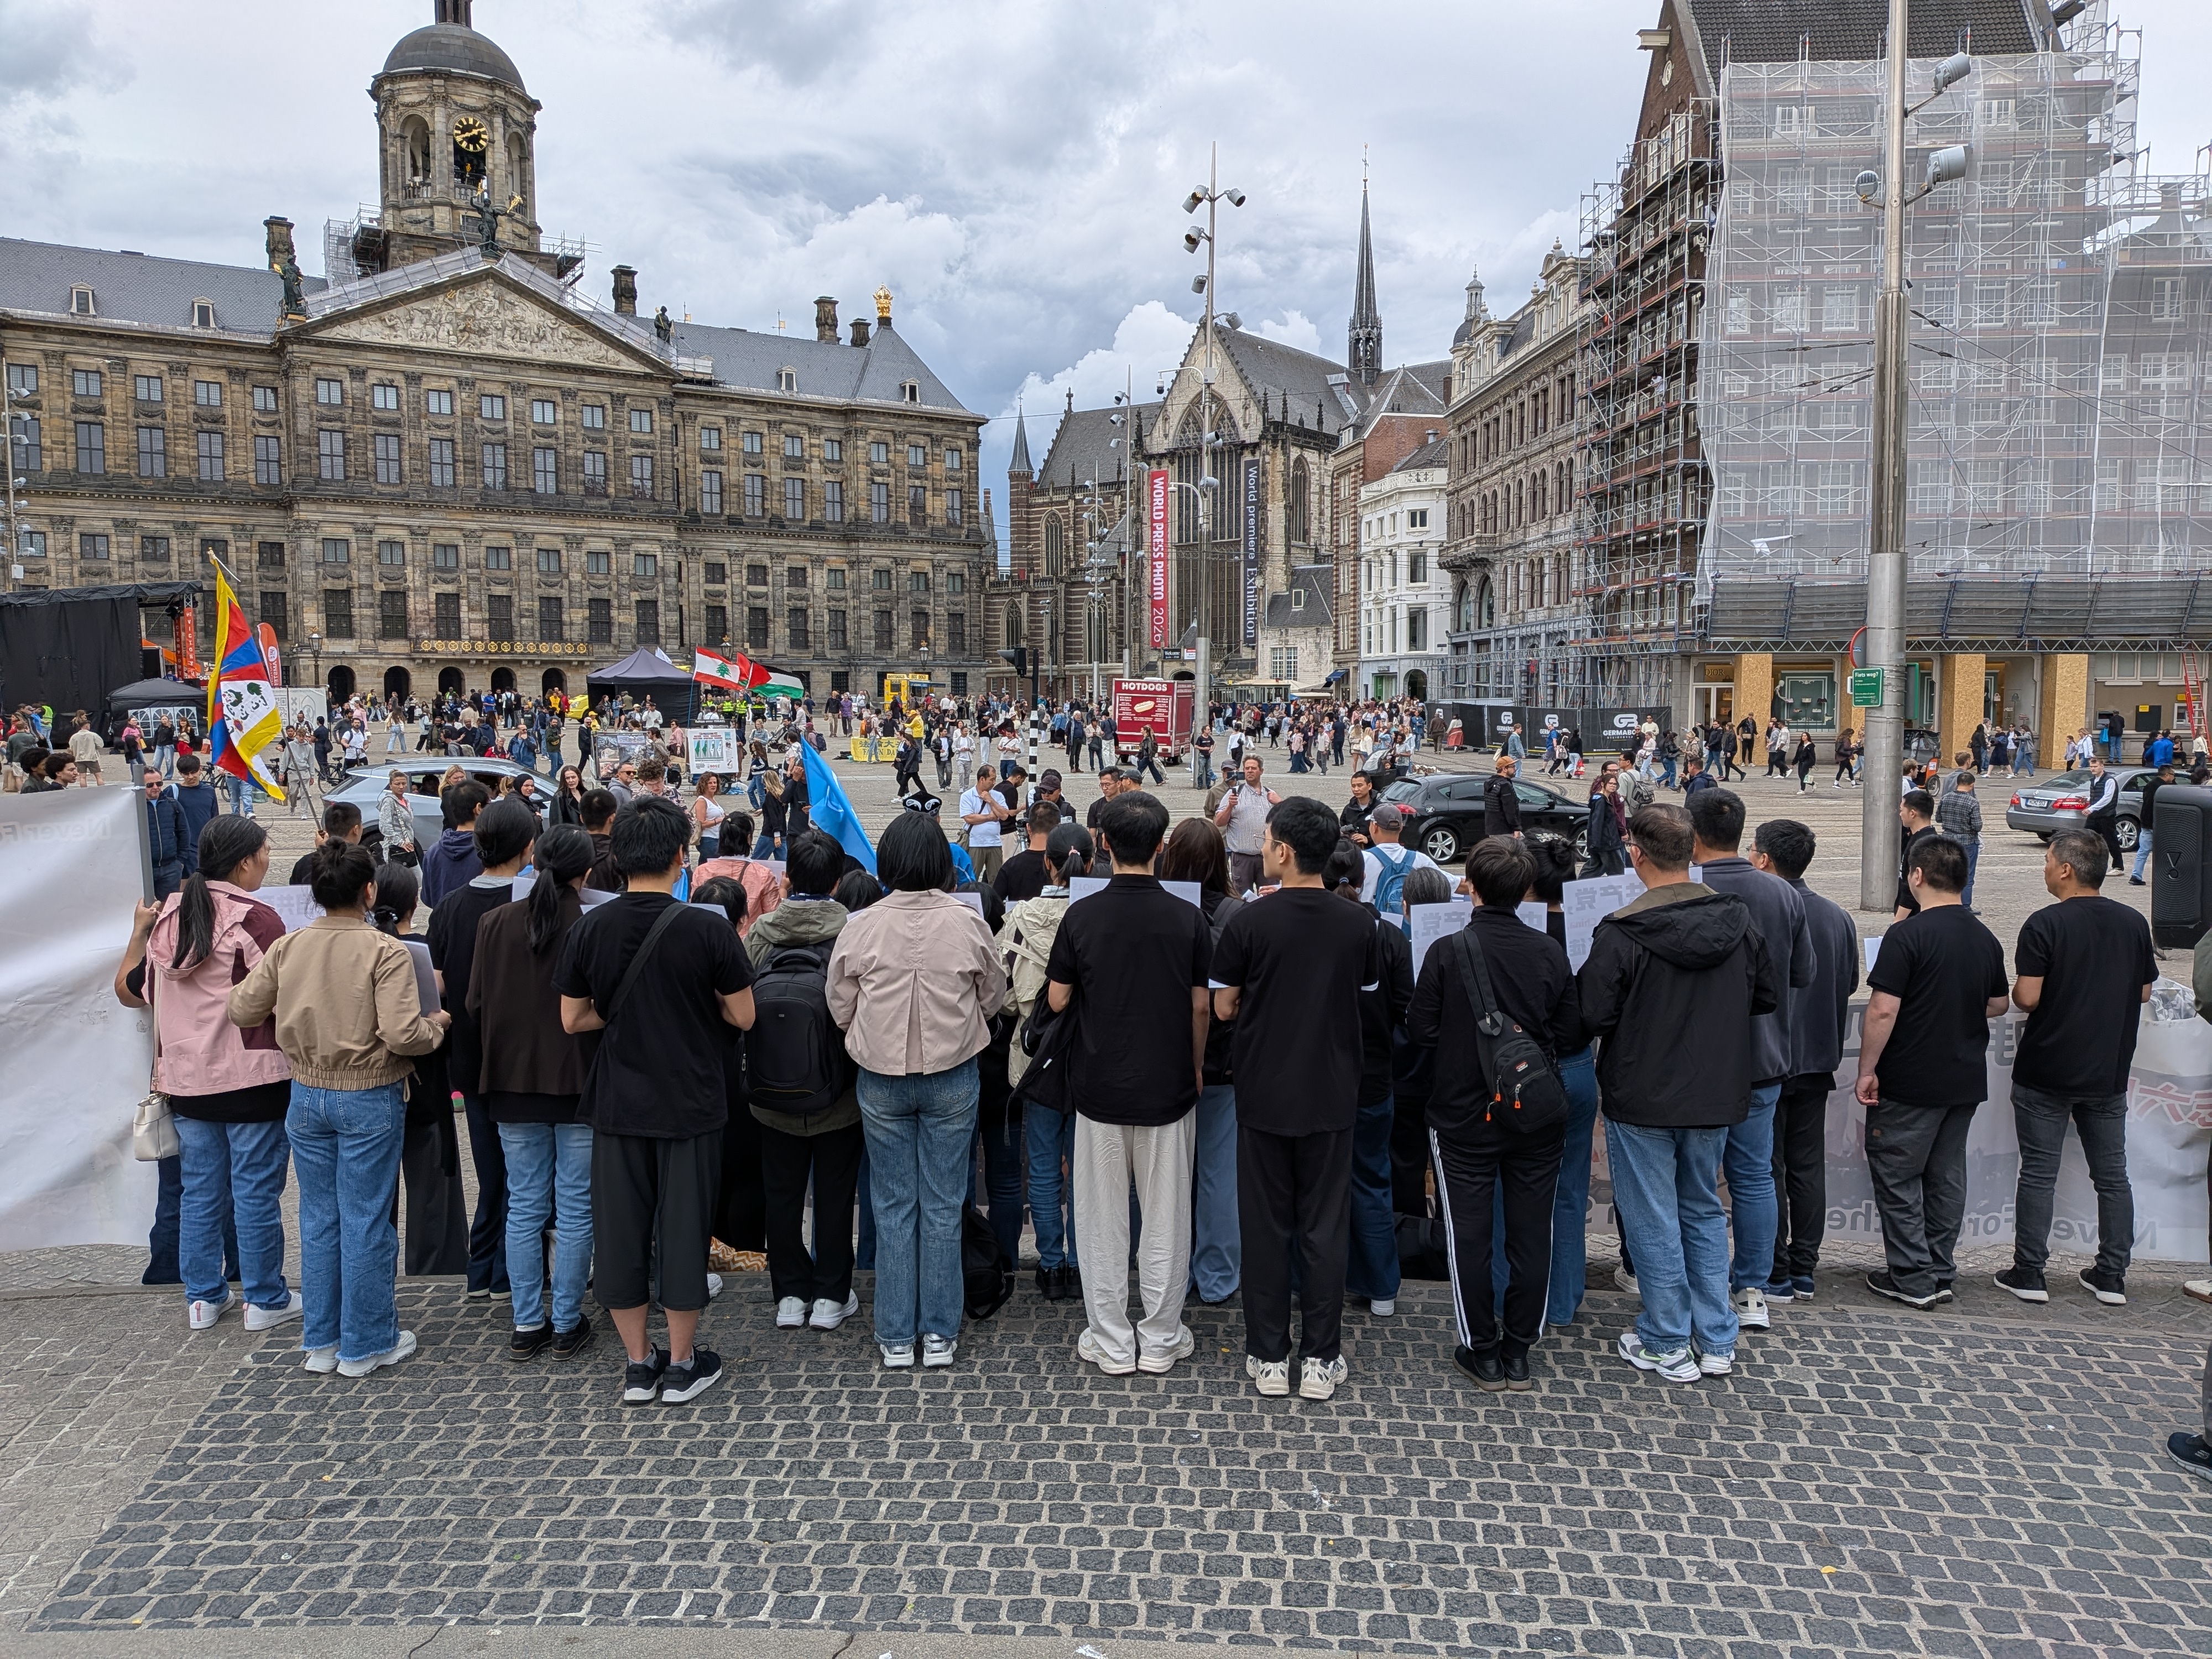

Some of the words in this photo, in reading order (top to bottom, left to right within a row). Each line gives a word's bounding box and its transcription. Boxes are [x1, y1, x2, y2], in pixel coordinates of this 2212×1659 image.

[1152, 477, 1165, 520] WORLD
[1248, 466, 1258, 502] World
[1152, 523, 1164, 559] PRESS
[1246, 505, 1255, 560] premiere
[1153, 561, 1164, 601] PHOTO
[1246, 567, 1258, 638] Exhibition
[1153, 608, 1164, 643] 2026
[1121, 682, 1167, 692] HOTDOGS
